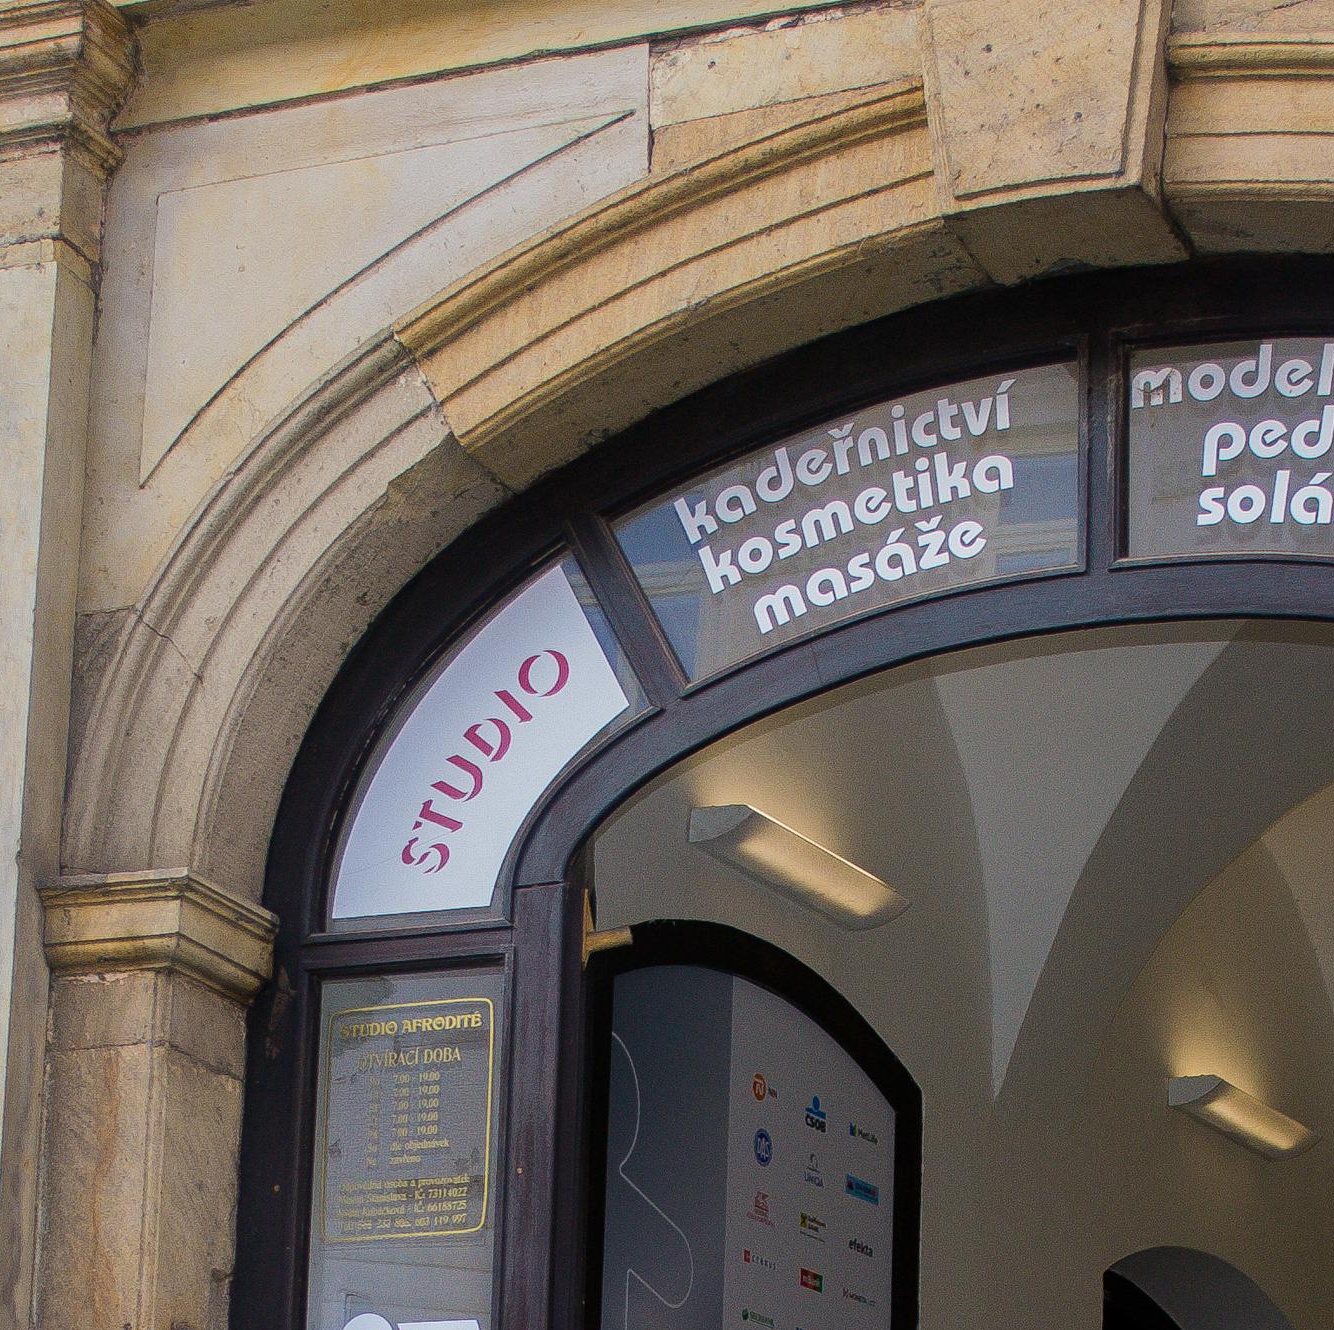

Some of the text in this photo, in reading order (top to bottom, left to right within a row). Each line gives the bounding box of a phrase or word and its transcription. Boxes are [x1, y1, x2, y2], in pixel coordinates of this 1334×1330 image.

[674, 379, 1017, 544] kadeřnictví
[698, 452, 1014, 594] kosmetika
[753, 515, 987, 634] masáže
[402, 650, 569, 874] STUDIO
[423, 1046, 463, 1063] DOBA
